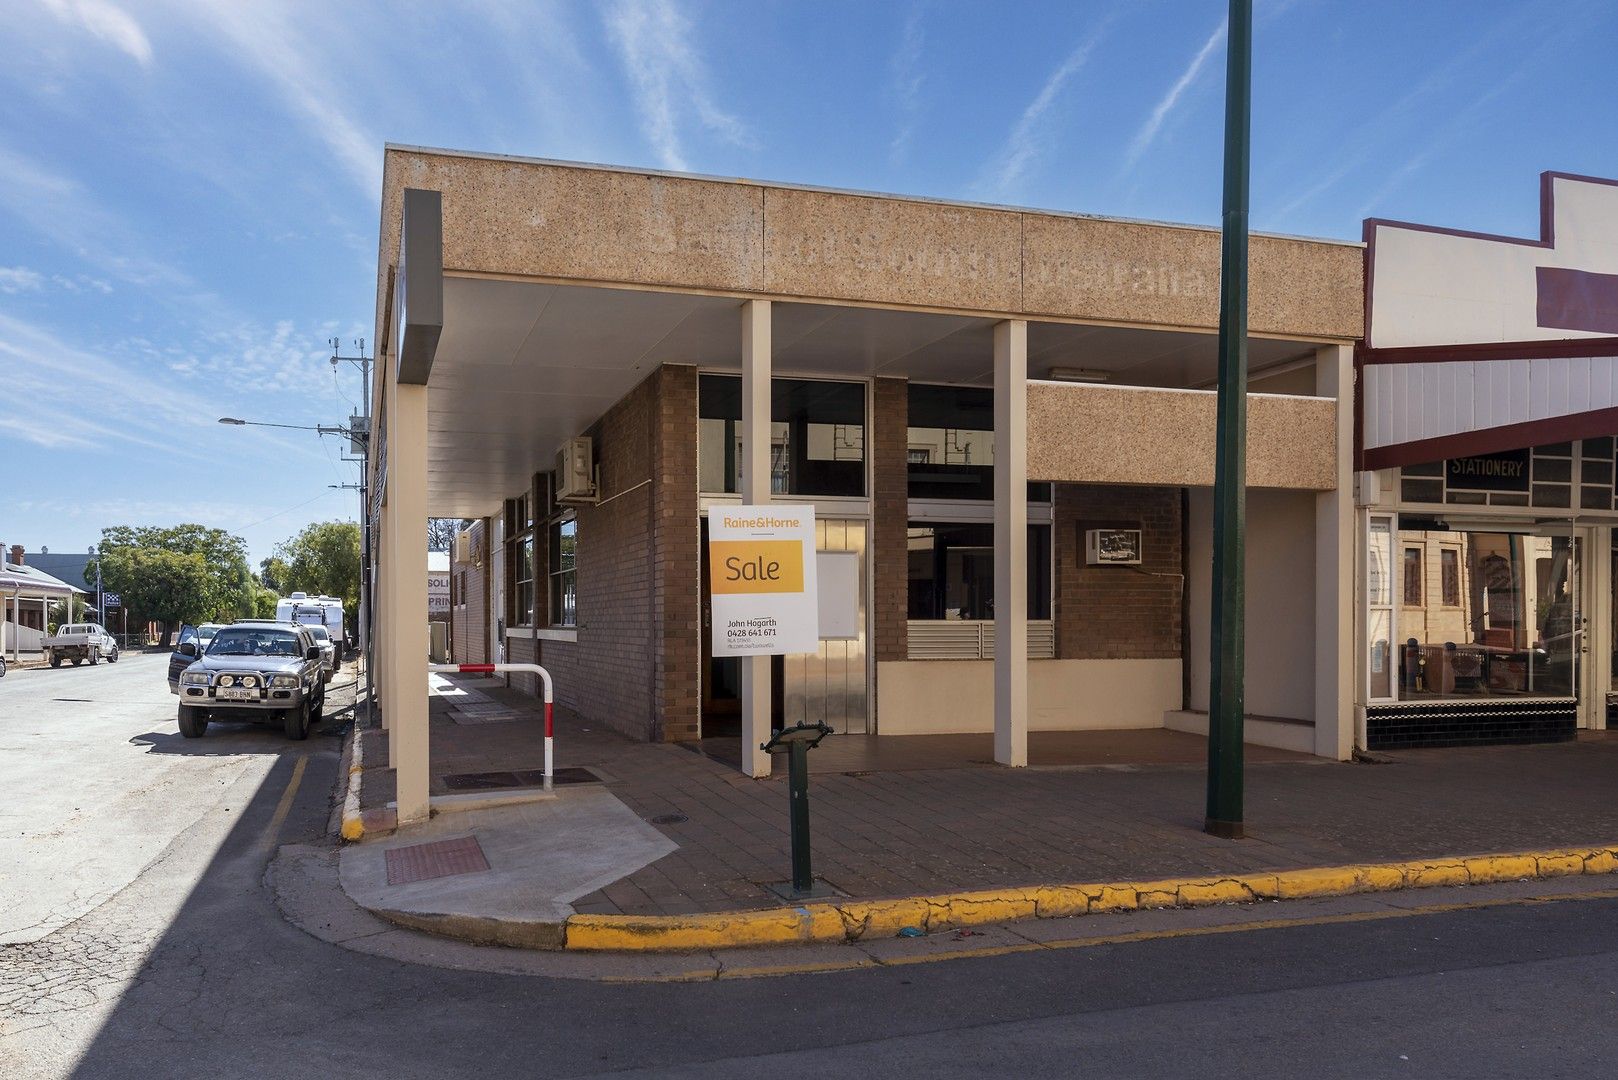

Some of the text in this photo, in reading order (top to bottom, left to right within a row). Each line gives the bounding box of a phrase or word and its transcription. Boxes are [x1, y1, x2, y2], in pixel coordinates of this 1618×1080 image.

[1452, 458, 1523, 477] STATIONERY
[724, 517, 800, 528] Raine&Horne
[726, 556, 780, 581] Sale
[727, 619, 777, 628] John Hogarth
[727, 628, 777, 637] 0428 641 671
